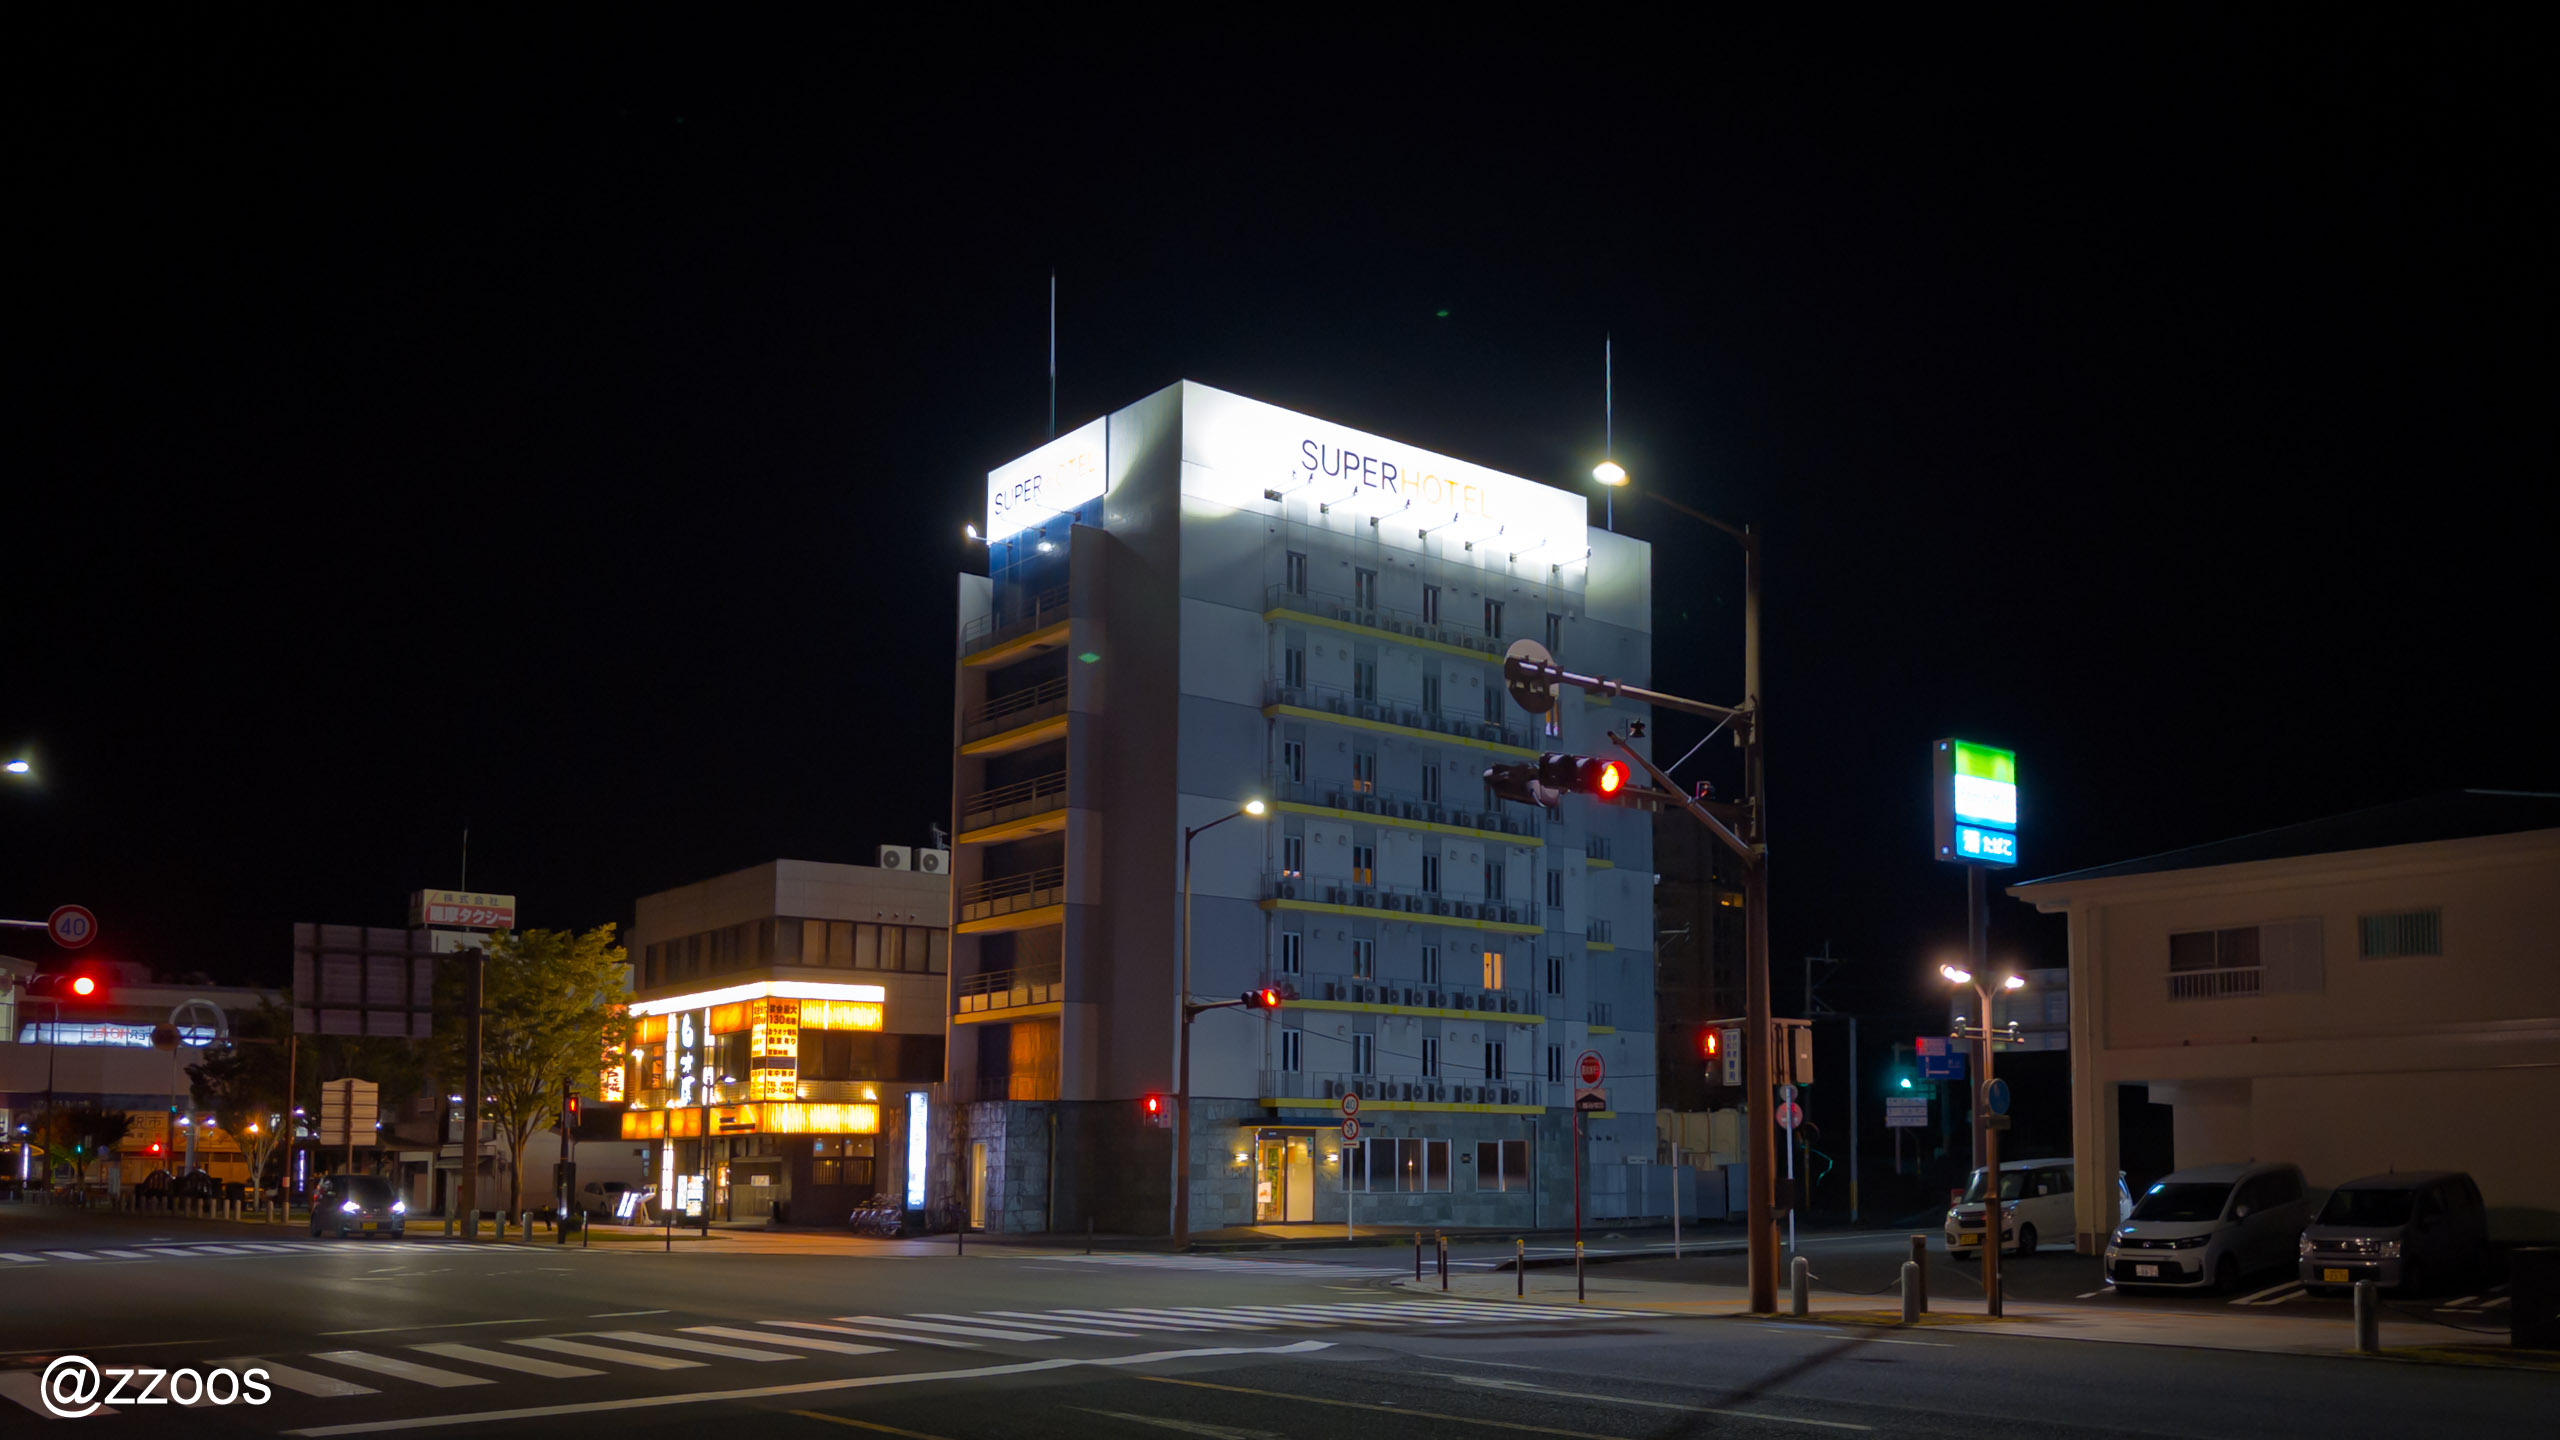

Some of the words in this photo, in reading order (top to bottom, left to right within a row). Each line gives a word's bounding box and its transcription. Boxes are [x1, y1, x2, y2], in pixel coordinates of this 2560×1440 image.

[994, 474, 1042, 515] SUPER
[1045, 451, 1096, 494] OTEL
[1301, 439, 1398, 494] SUPER
[1401, 466, 1494, 519] HOTEL
[1983, 835, 2012, 856] たばこ
[443, 893, 499, 907] 株式会社
[58, 917, 86, 936] 40
[1345, 1099, 1356, 1110] 40
